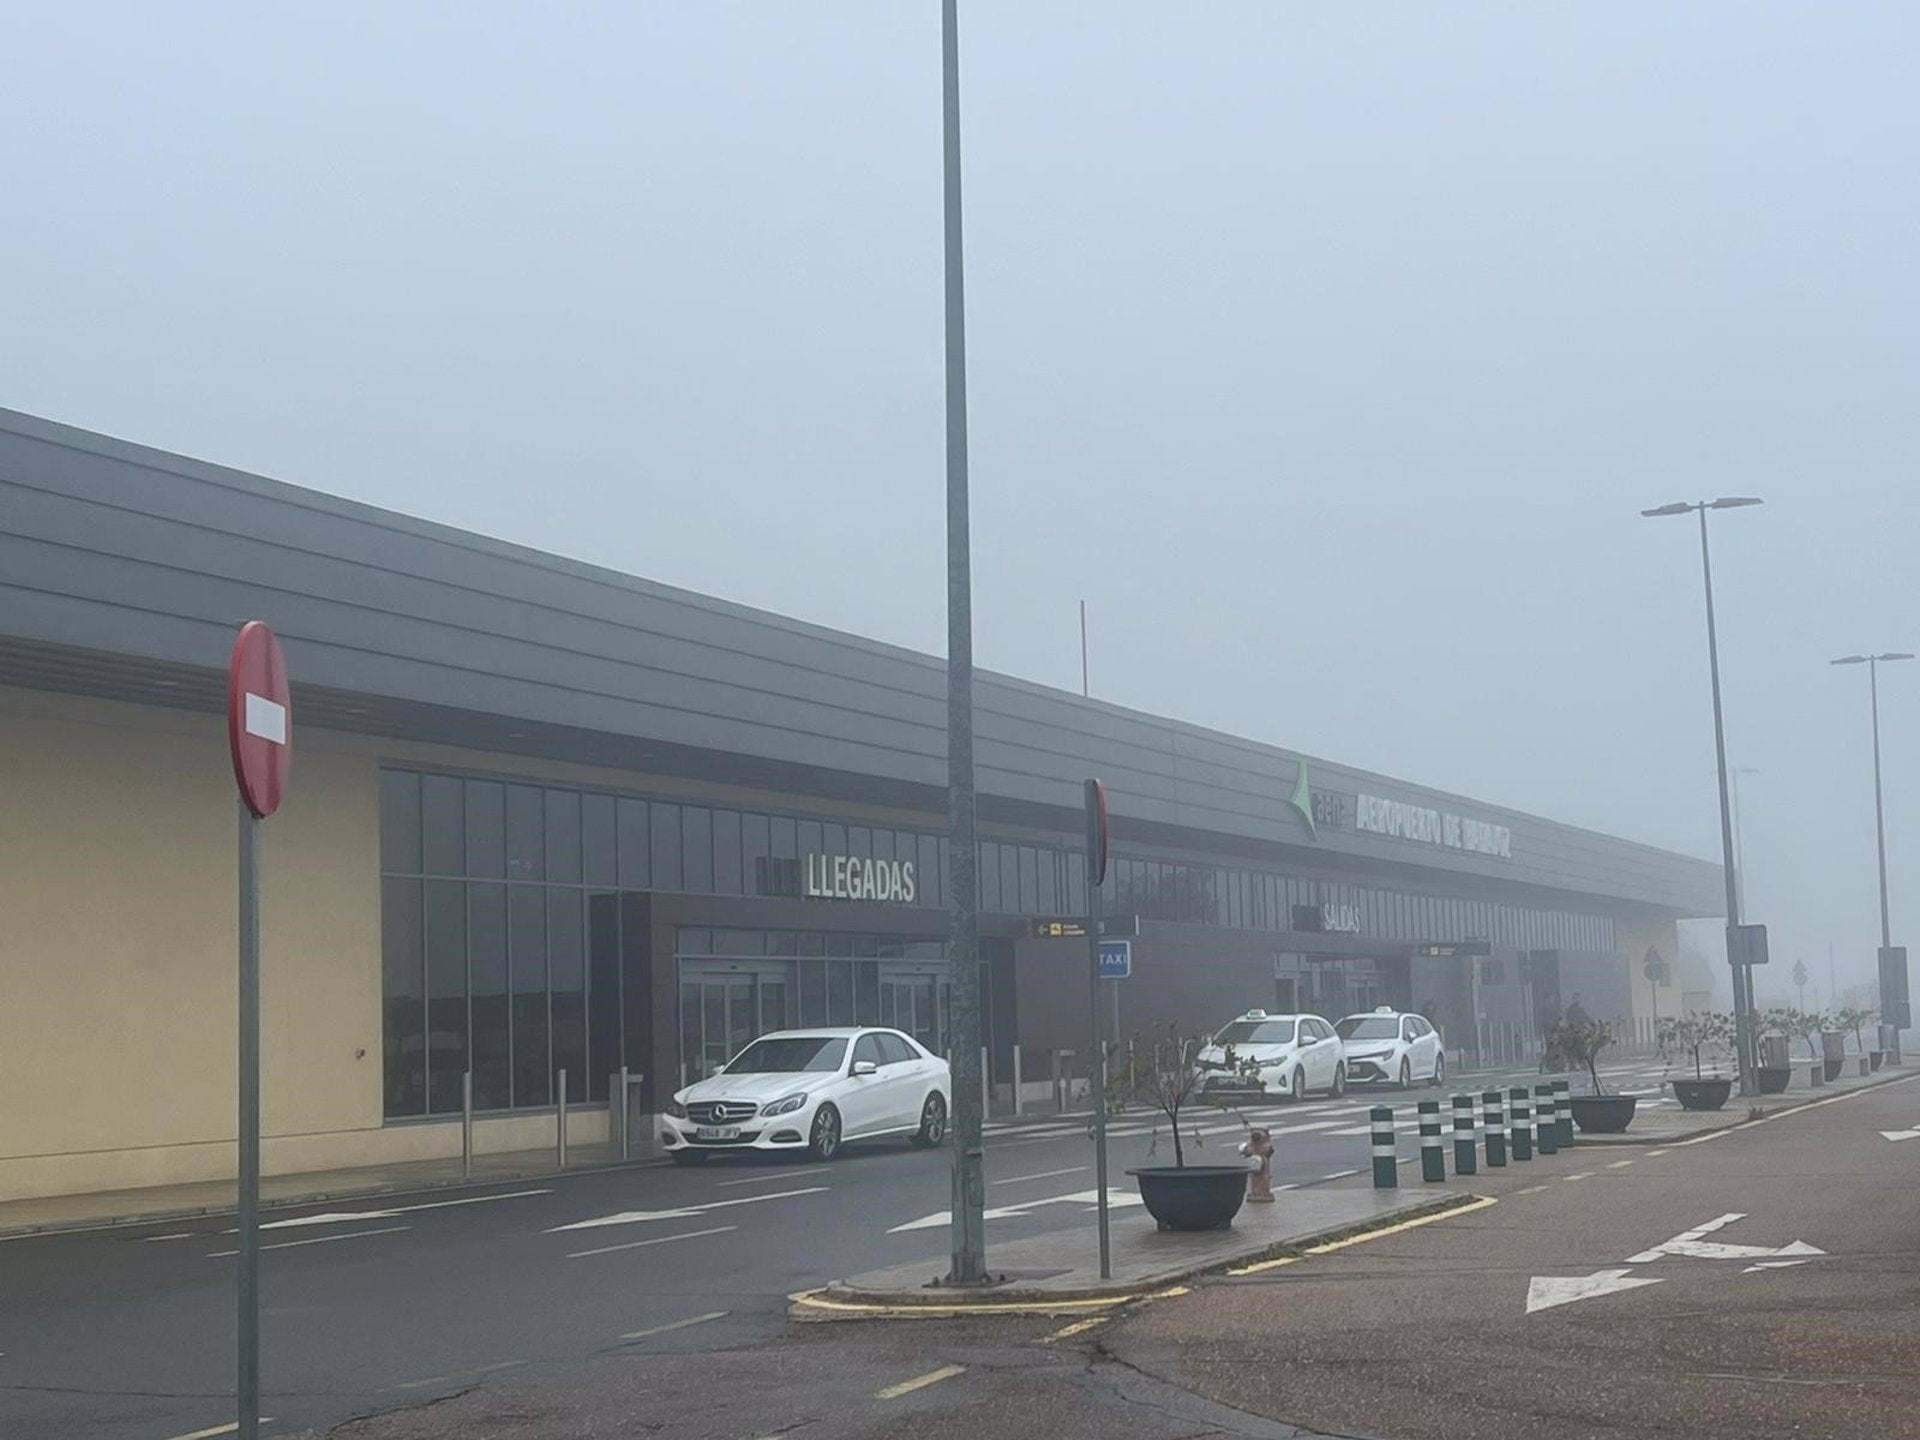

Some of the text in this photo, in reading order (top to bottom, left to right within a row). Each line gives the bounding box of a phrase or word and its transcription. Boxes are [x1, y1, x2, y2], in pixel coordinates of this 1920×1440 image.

[808, 853, 915, 902] LLEGADAS
[1324, 902, 1360, 934] SALIDAS
[1099, 953, 1127, 965] TAXI
